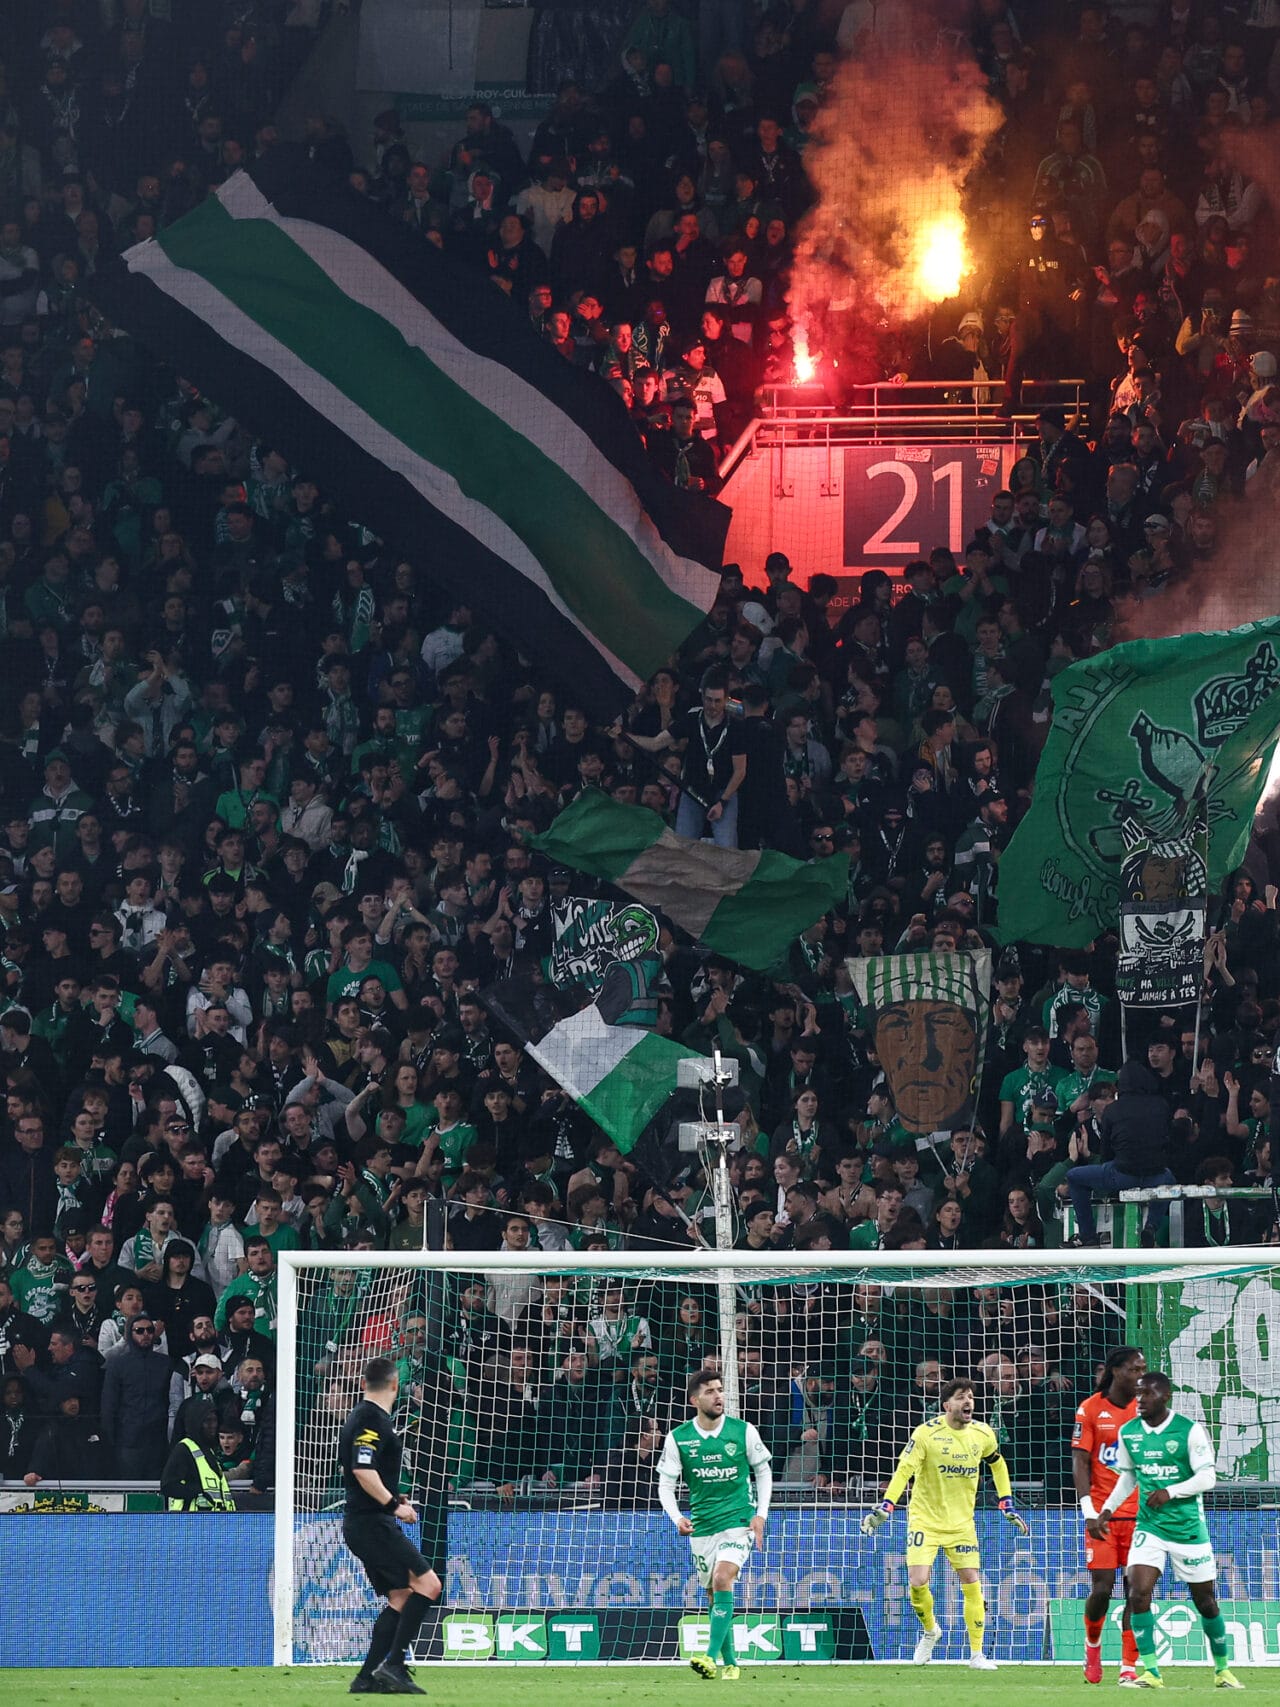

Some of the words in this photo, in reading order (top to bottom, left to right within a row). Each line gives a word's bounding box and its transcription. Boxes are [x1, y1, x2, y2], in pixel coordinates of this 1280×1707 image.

[863, 460, 963, 554] 21
[700, 1466, 738, 1479] Kelyps
[947, 1465, 978, 1476] Kelyps
[446, 1622, 595, 1652] BKT
[681, 1622, 829, 1652] BKT
